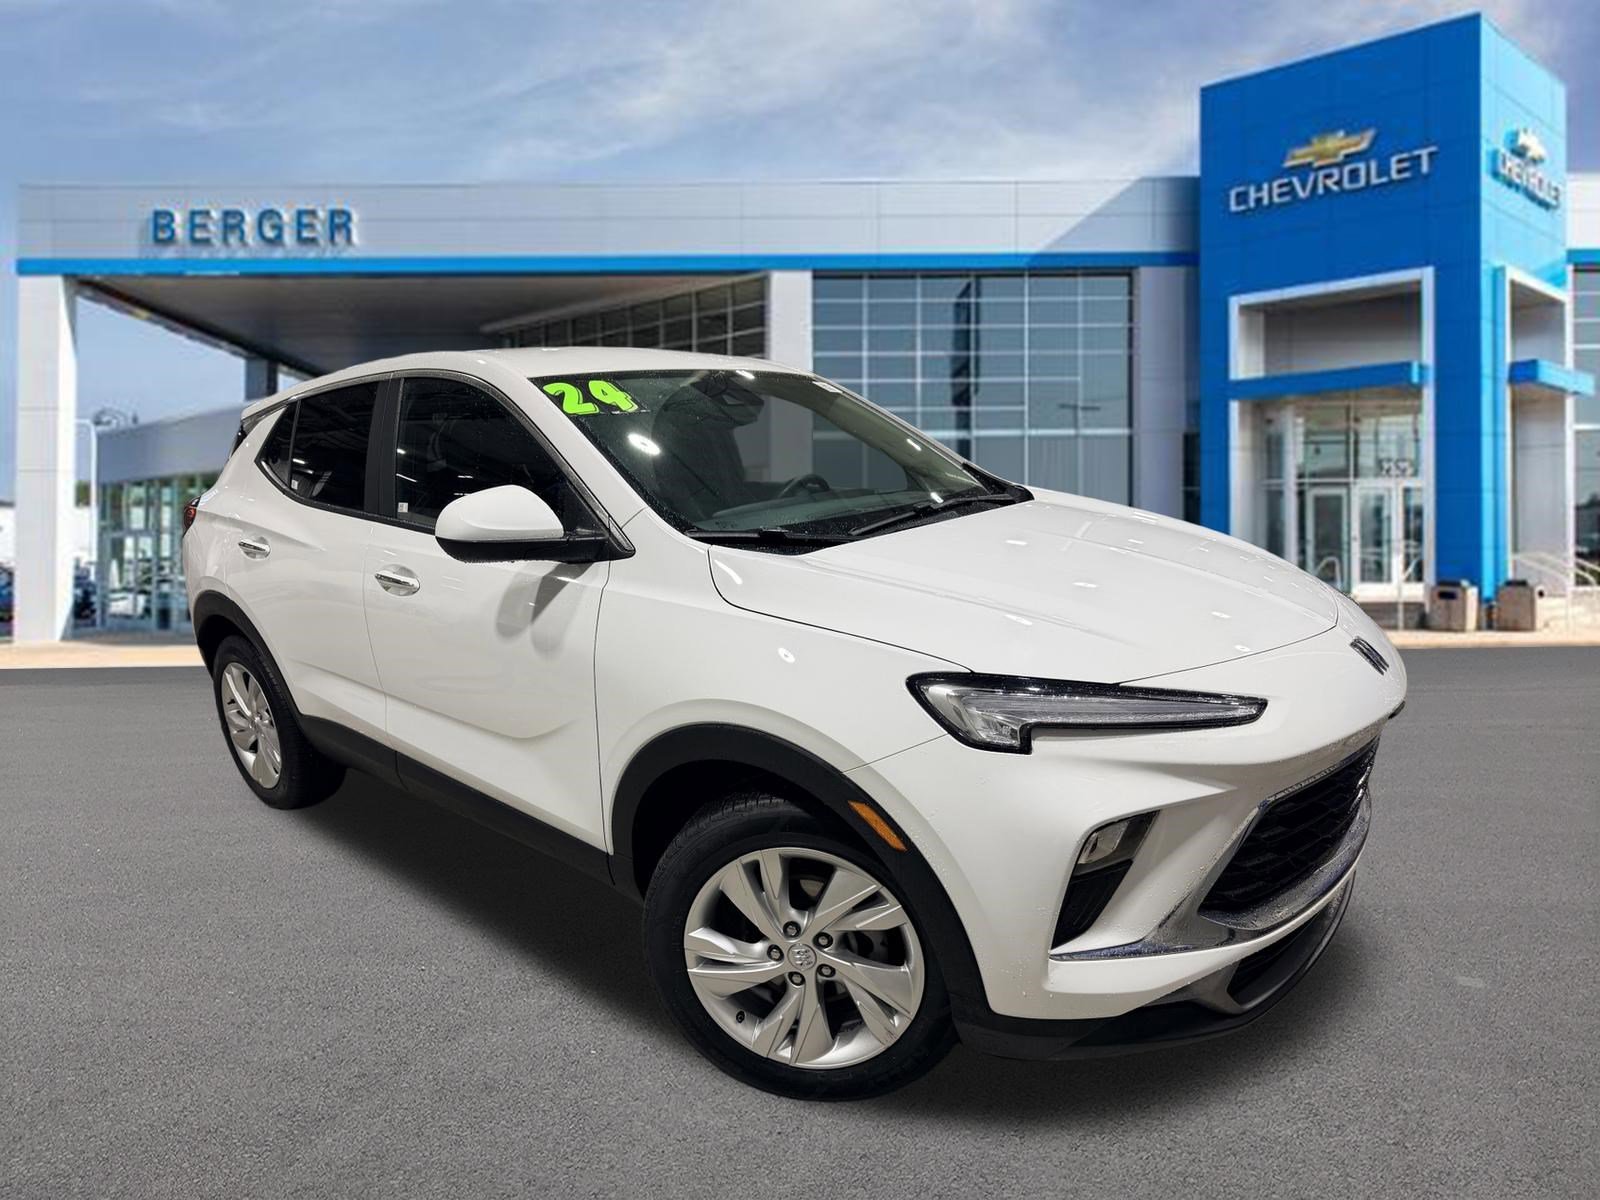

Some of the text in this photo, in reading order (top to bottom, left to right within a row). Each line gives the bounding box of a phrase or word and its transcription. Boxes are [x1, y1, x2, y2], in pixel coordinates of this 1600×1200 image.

[1229, 146, 1438, 213] CHEVROLET
[152, 208, 355, 245] BERGER
[542, 379, 639, 415] 24
